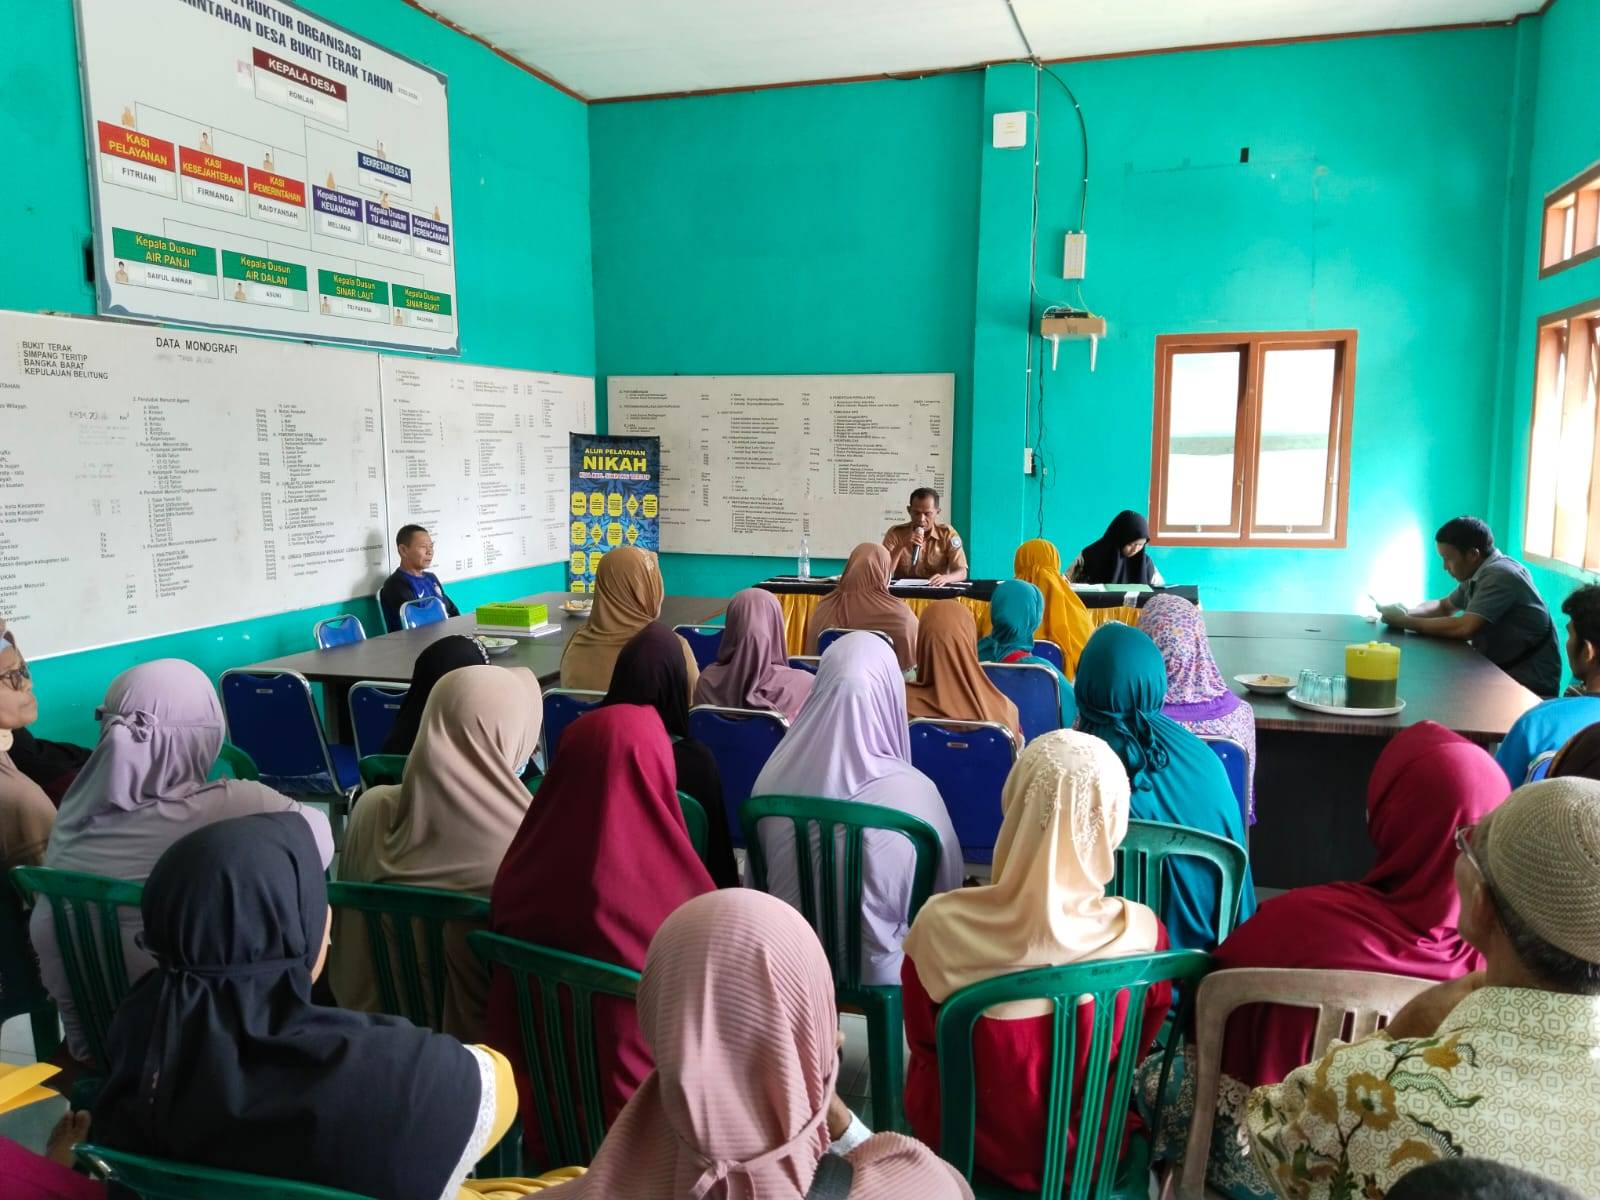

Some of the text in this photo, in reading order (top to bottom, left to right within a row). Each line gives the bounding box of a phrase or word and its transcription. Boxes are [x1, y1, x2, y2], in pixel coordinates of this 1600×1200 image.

[297, 20, 362, 61] ORGANISASI
[256, 21, 287, 47] DESA
[290, 37, 322, 63] BUKIT
[326, 53, 359, 79] TERAK
[361, 69, 394, 93] TAHUN
[268, 58, 336, 94] KEPALA DESA
[126, 132, 150, 148] KASI
[109, 141, 168, 166] PELAYANAN
[204, 157, 222, 169] KASI
[362, 155, 409, 179] SEKRETARIS DESA
[122, 167, 157, 183] FITRIANI
[182, 162, 244, 186] KESEJAHTERAAN
[270, 176, 285, 188] KASI
[197, 187, 234, 203] FIRMANDA
[253, 182, 302, 203] PEMERINTAHAN
[316, 189, 359, 208] Kepala Urusan
[321, 201, 356, 217] KEUANGAN
[369, 204, 407, 220] Kepala Urusan
[370, 214, 379, 223] TU
[414, 218, 447, 233] Kepala Urusan
[413, 226, 449, 243] PERENCANAAN
[136, 235, 197, 257] Kepala Dusun
[145, 252, 190, 269] AIR PANJI
[240, 256, 291, 274] Kepala Dusun
[245, 270, 288, 286] AIR DALAM
[333, 274, 376, 289] Kepala Dusun
[336, 286, 374, 301] SINAR LAUT
[404, 288, 440, 302] Kepala Dusun
[406, 299, 440, 312] SINAR BUKIT
[22, 340, 72, 352] BUKIT TERAK
[156, 337, 238, 354] DATA MONOGRAFI
[23, 350, 88, 361] SIMPANG TERITIP
[24, 358, 84, 370] BANGKA BARAT
[25, 367, 108, 380] KEPULAUAN BELITUNG
[605, 448, 645, 456] PELAYANAN
[583, 455, 647, 472] NIKAH
